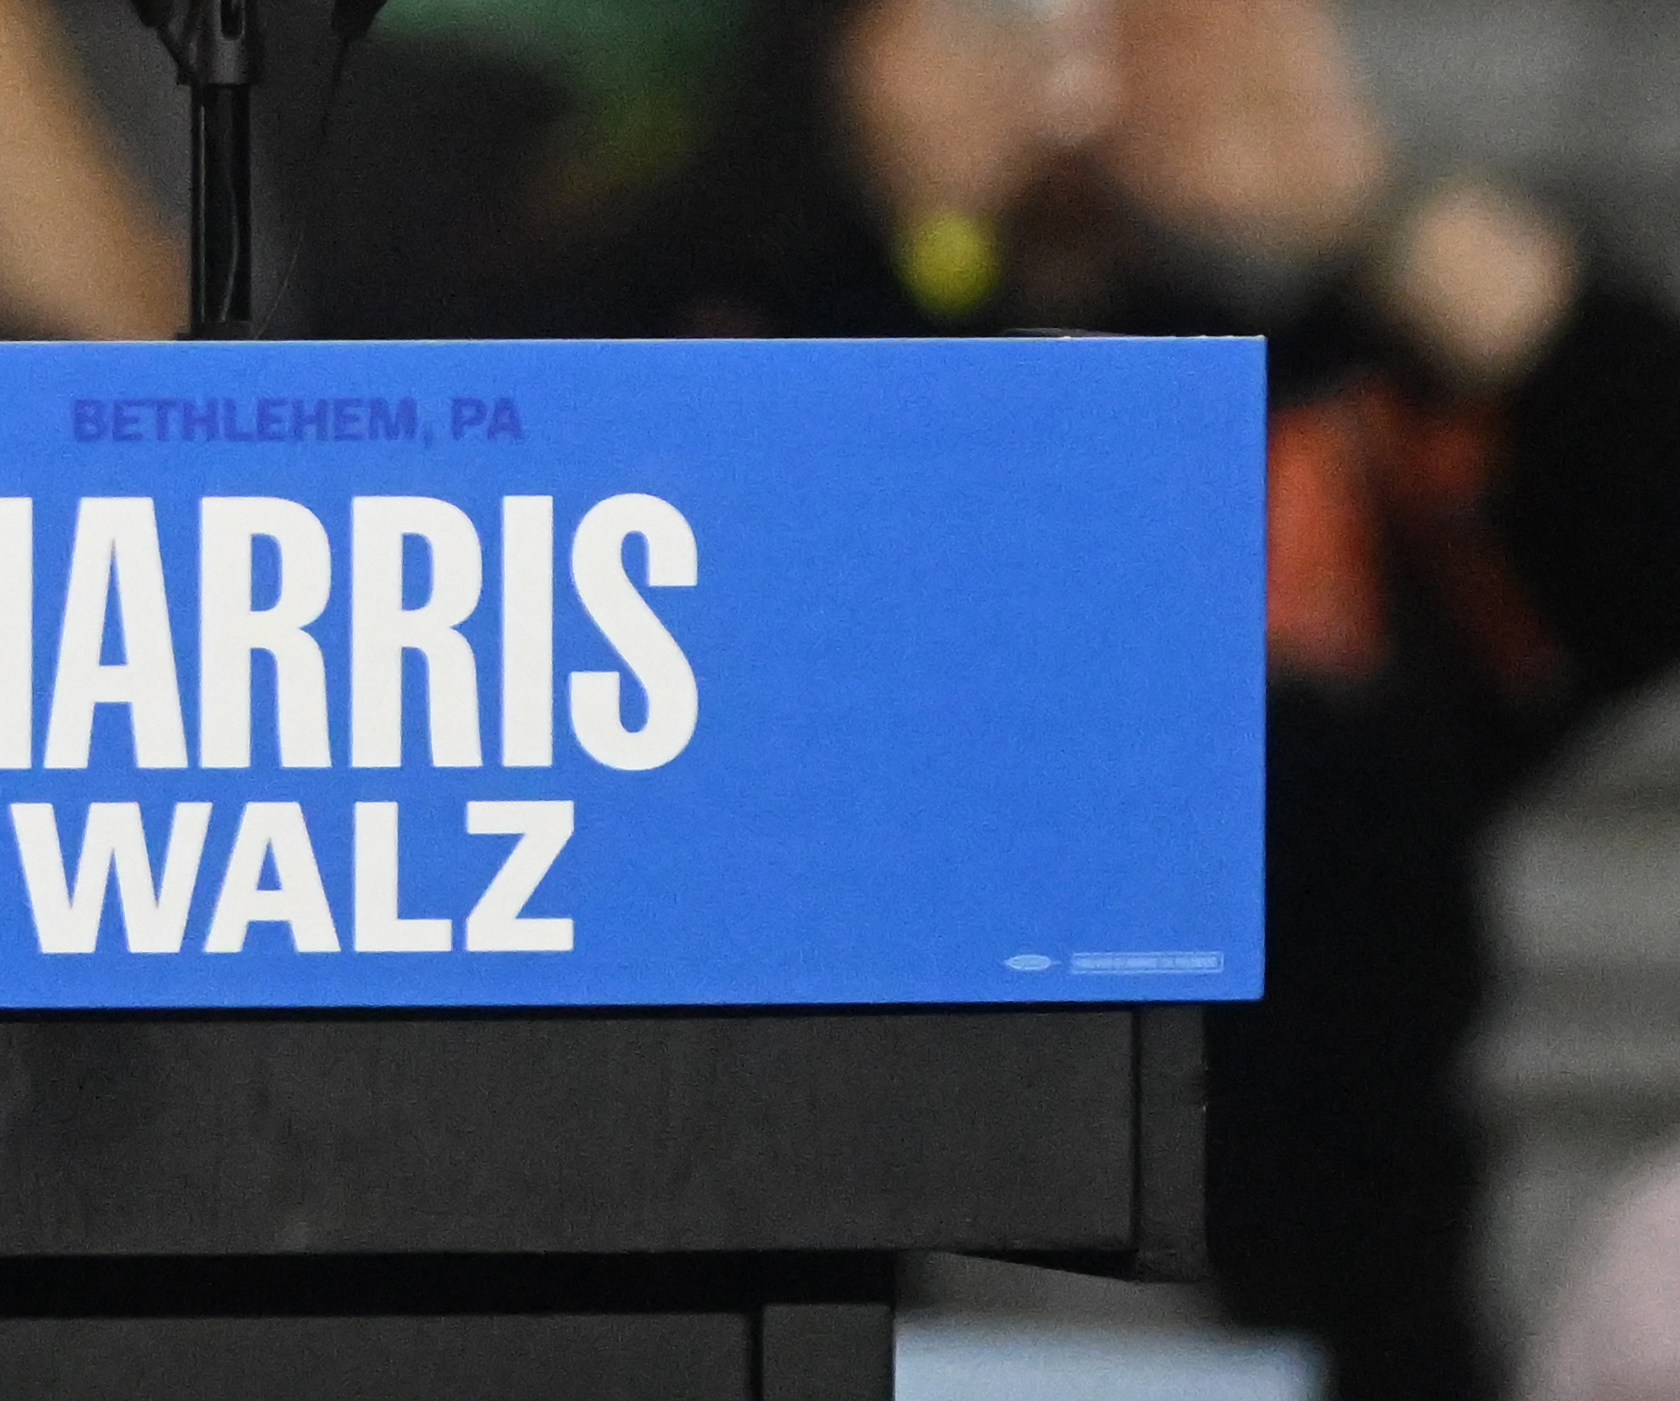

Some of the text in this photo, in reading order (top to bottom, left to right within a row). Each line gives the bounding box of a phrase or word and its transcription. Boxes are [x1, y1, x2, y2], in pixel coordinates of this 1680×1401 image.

[71, 396, 525, 448] BETHLEHEM, PA
[13, 800, 575, 955] WALZ
